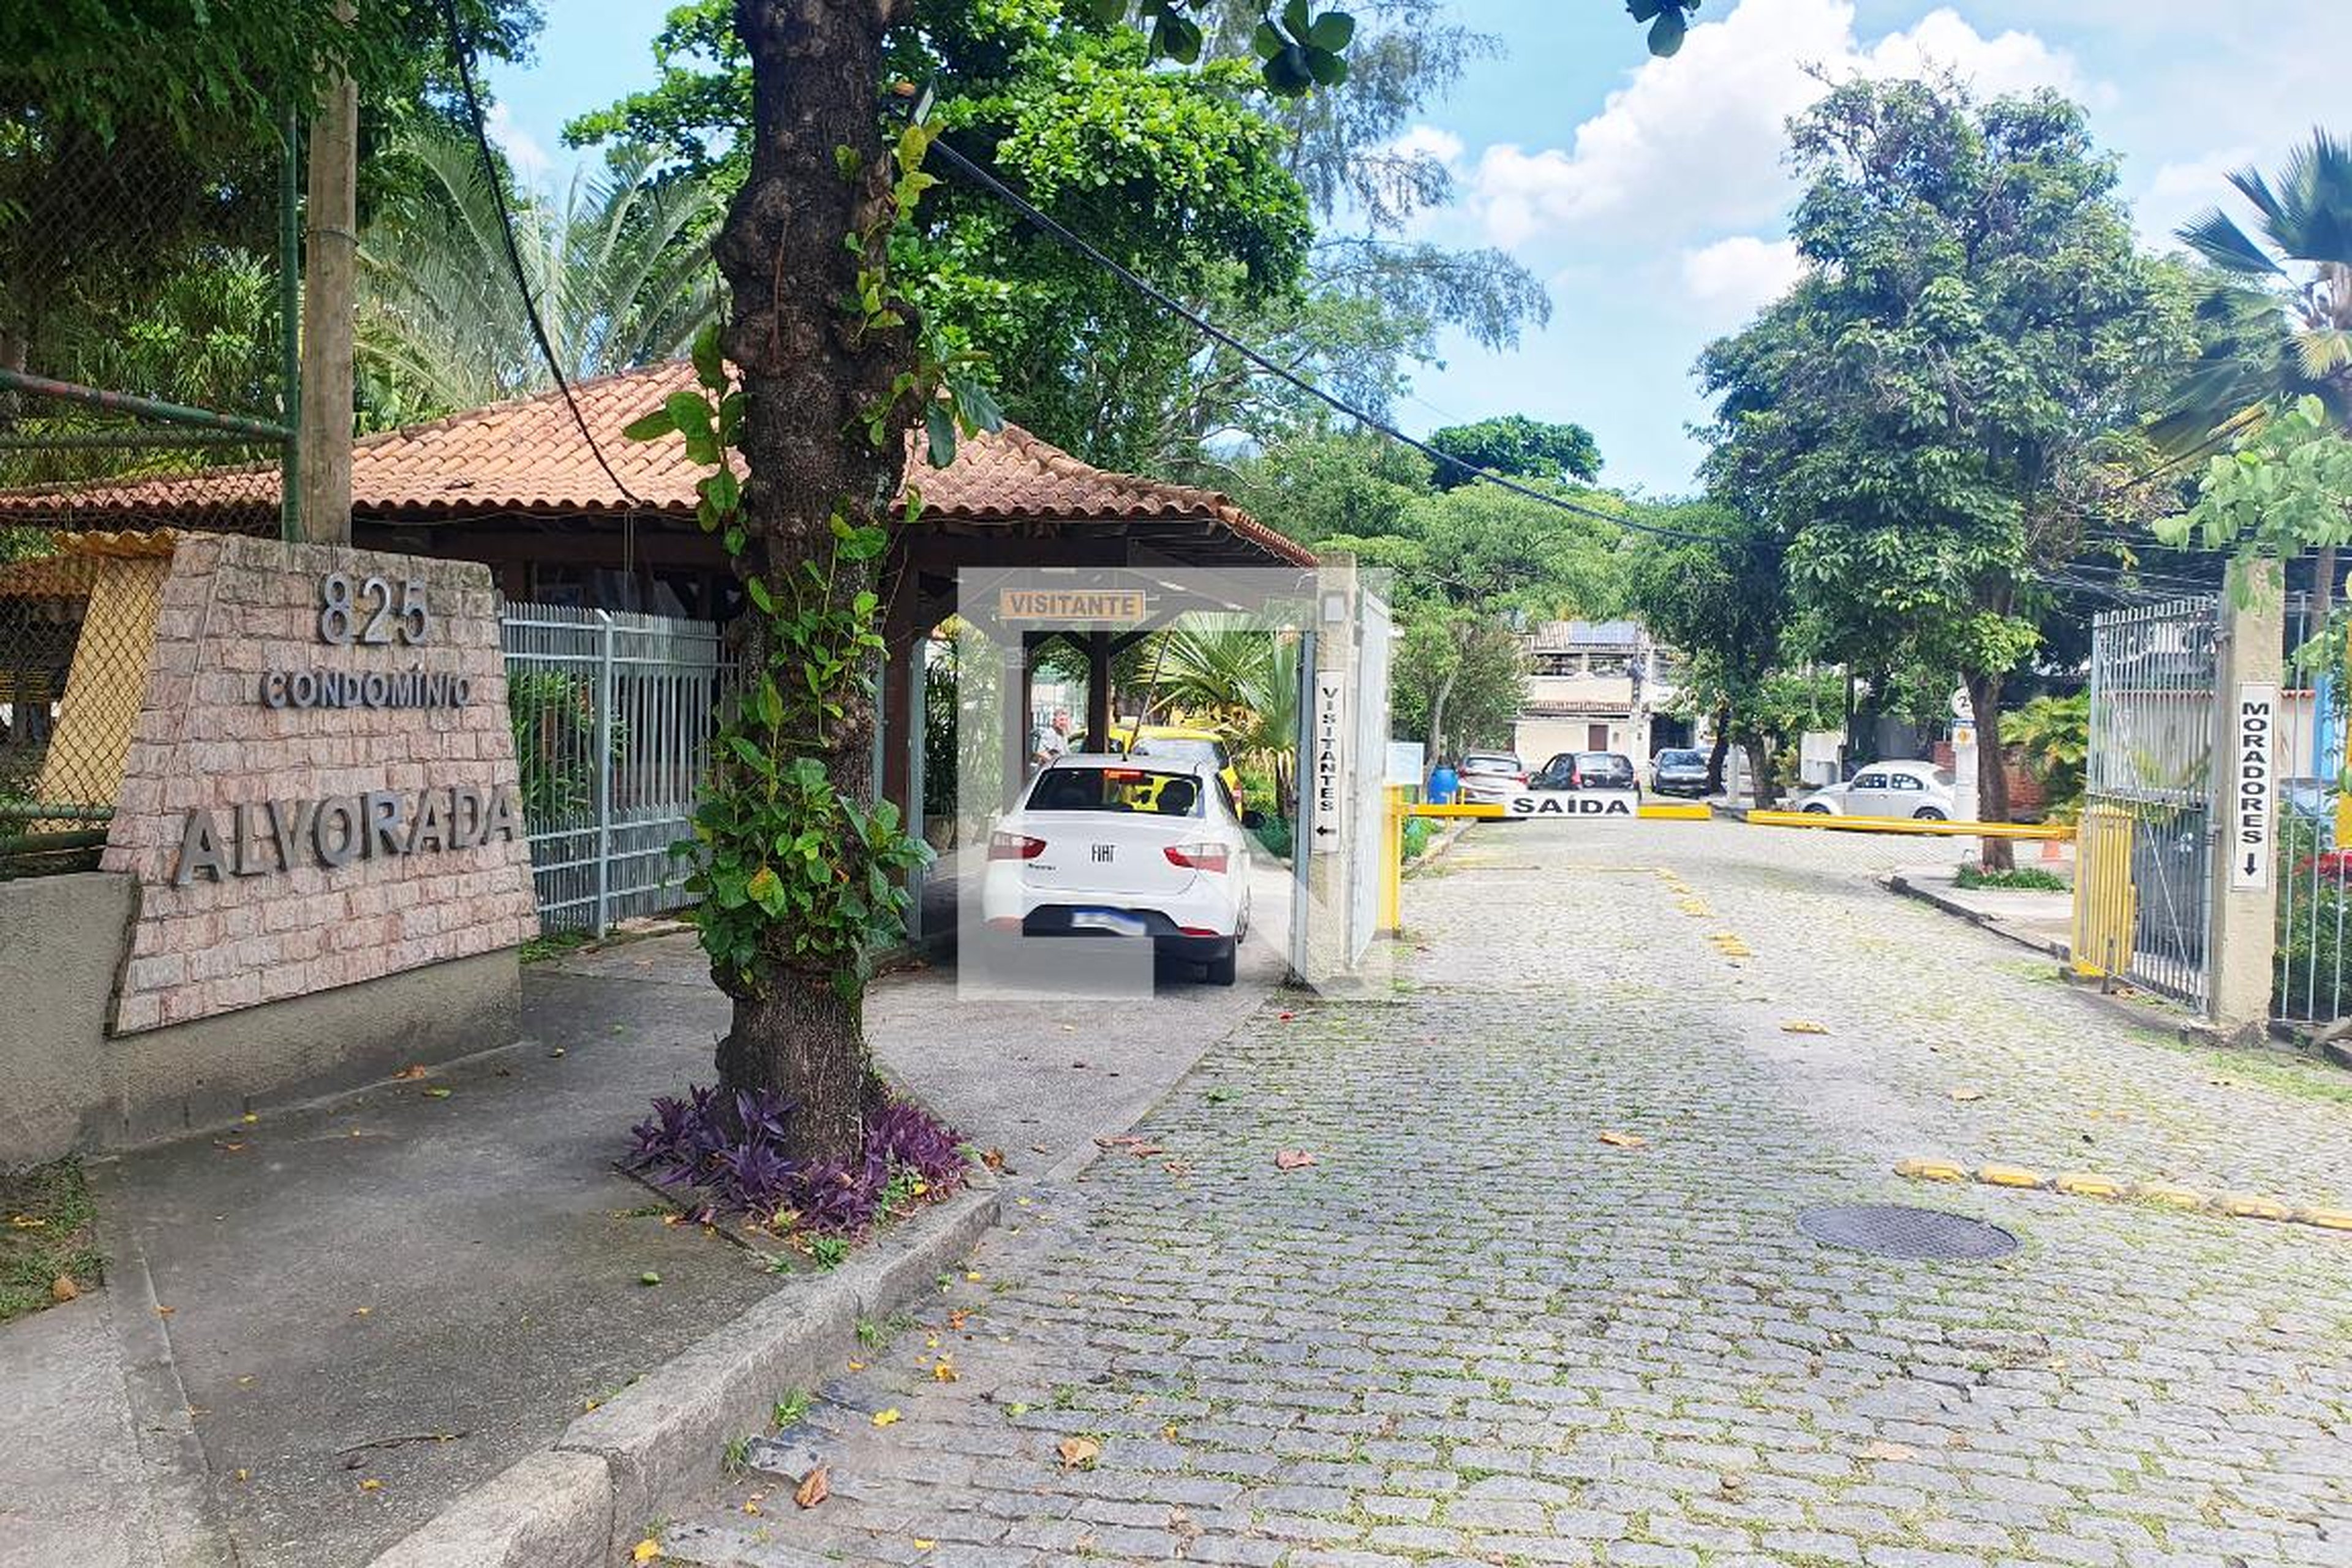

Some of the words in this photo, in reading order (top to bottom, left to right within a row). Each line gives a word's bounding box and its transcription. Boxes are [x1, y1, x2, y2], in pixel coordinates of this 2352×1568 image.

[320, 572, 429, 645] 825
[1011, 594, 1134, 615] VISITANTE
[262, 663, 472, 708] CONDOMÍNIO
[1319, 687, 1338, 812] VISITANTES
[2241, 703, 2269, 844] MORADORES
[172, 783, 522, 888] ALVORADA
[1091, 845, 1116, 862] FIAT
